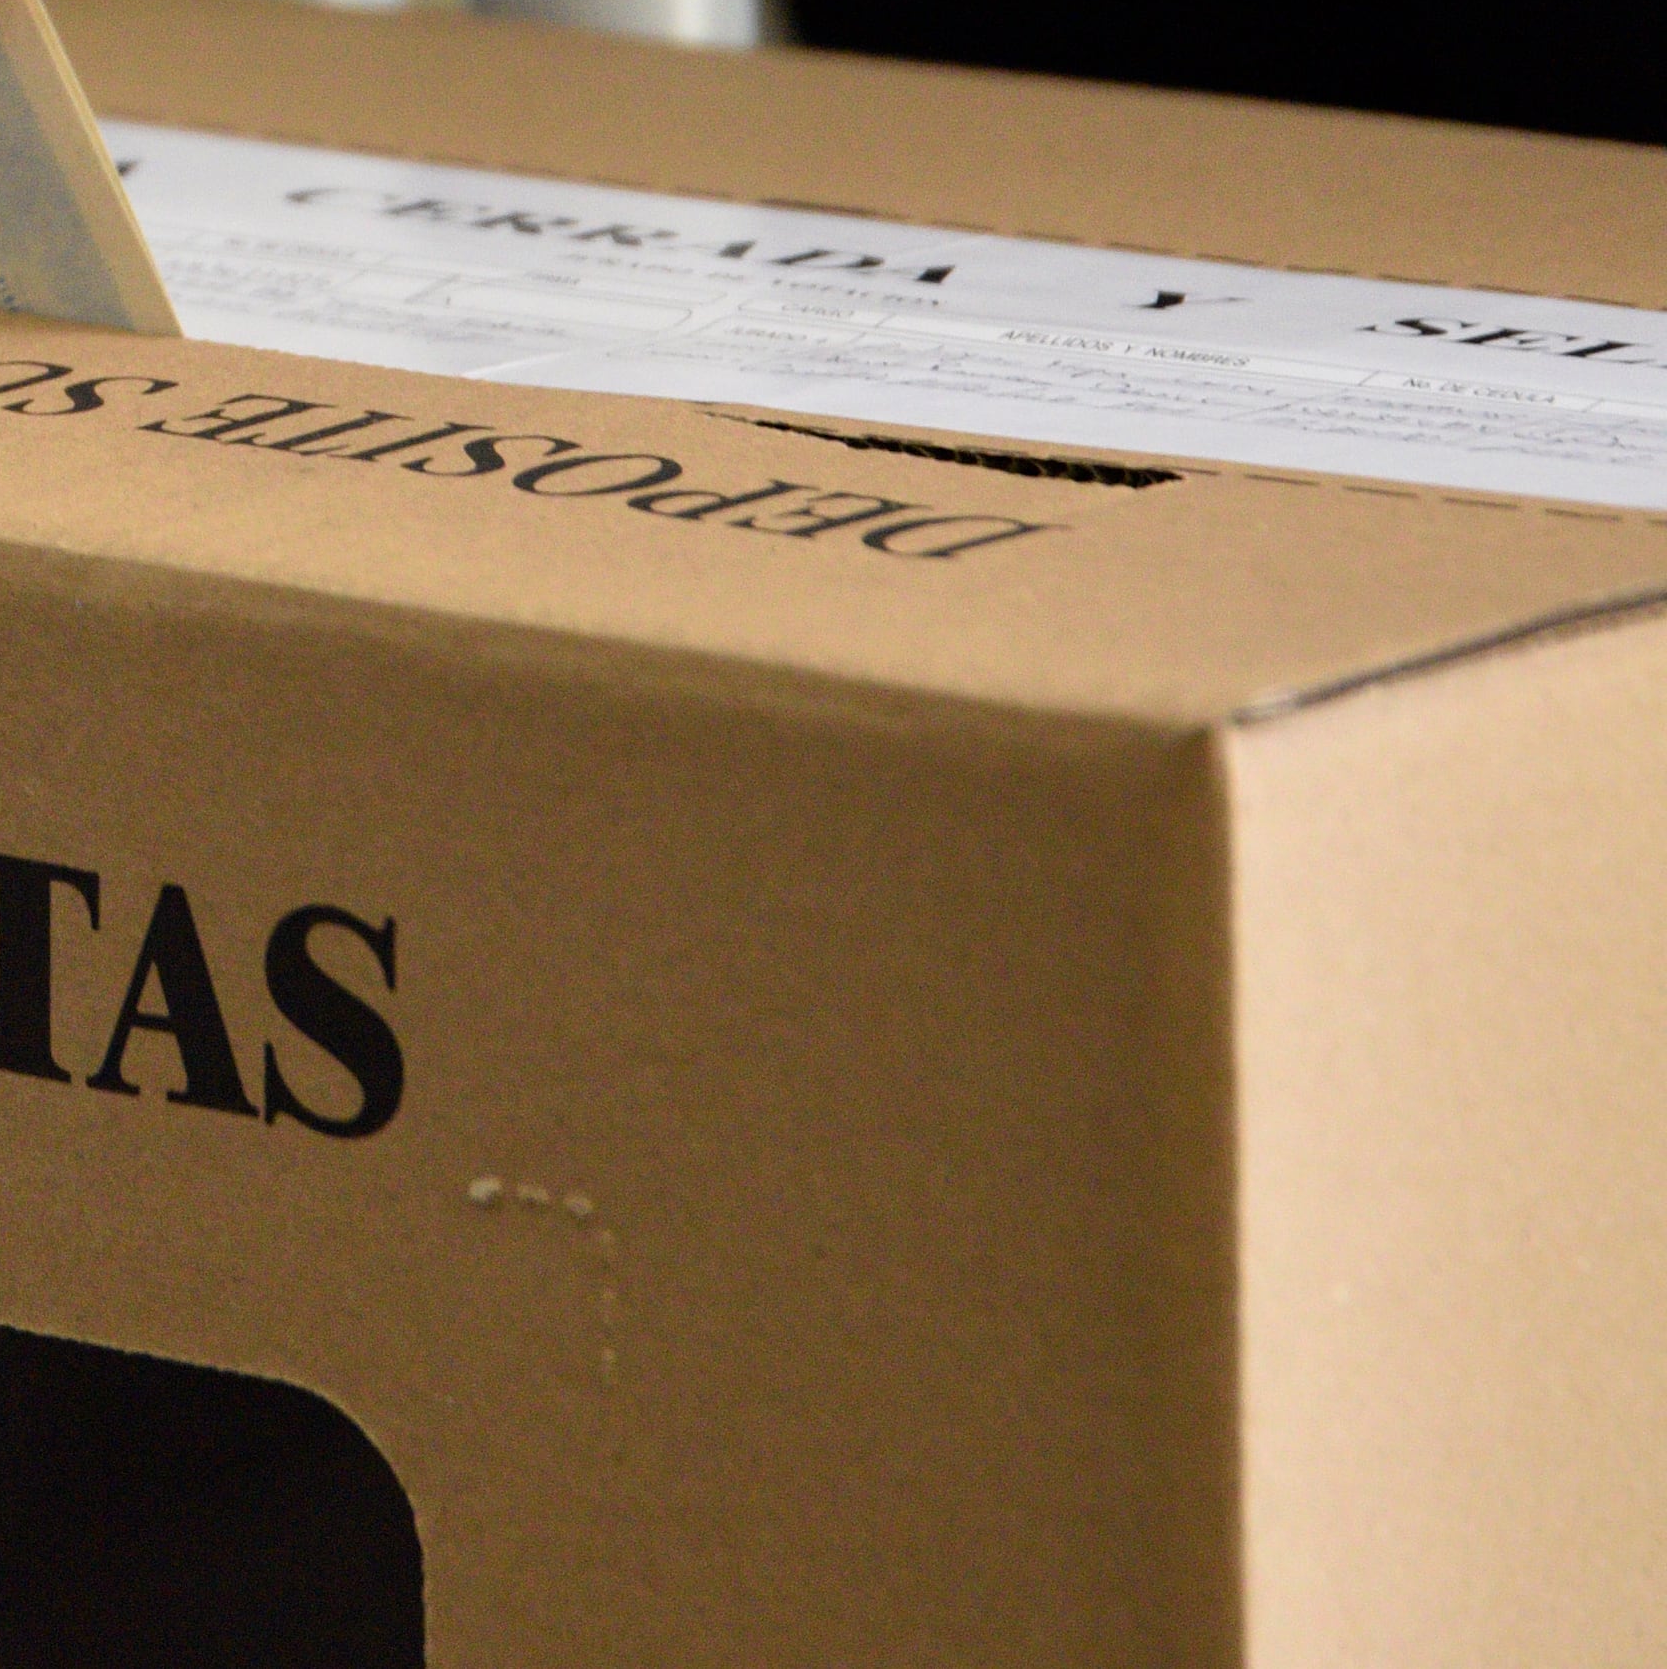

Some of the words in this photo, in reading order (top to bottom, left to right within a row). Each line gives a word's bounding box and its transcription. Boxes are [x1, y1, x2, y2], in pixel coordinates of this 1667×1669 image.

[284, 187, 956, 284] CERRADA
[1357, 316, 1667, 371] SEL
[999, 329, 1113, 352] APELLIDOS
[1144, 346, 1251, 368] NOMBRES
[136, 393, 1072, 559] DEPOSITE
